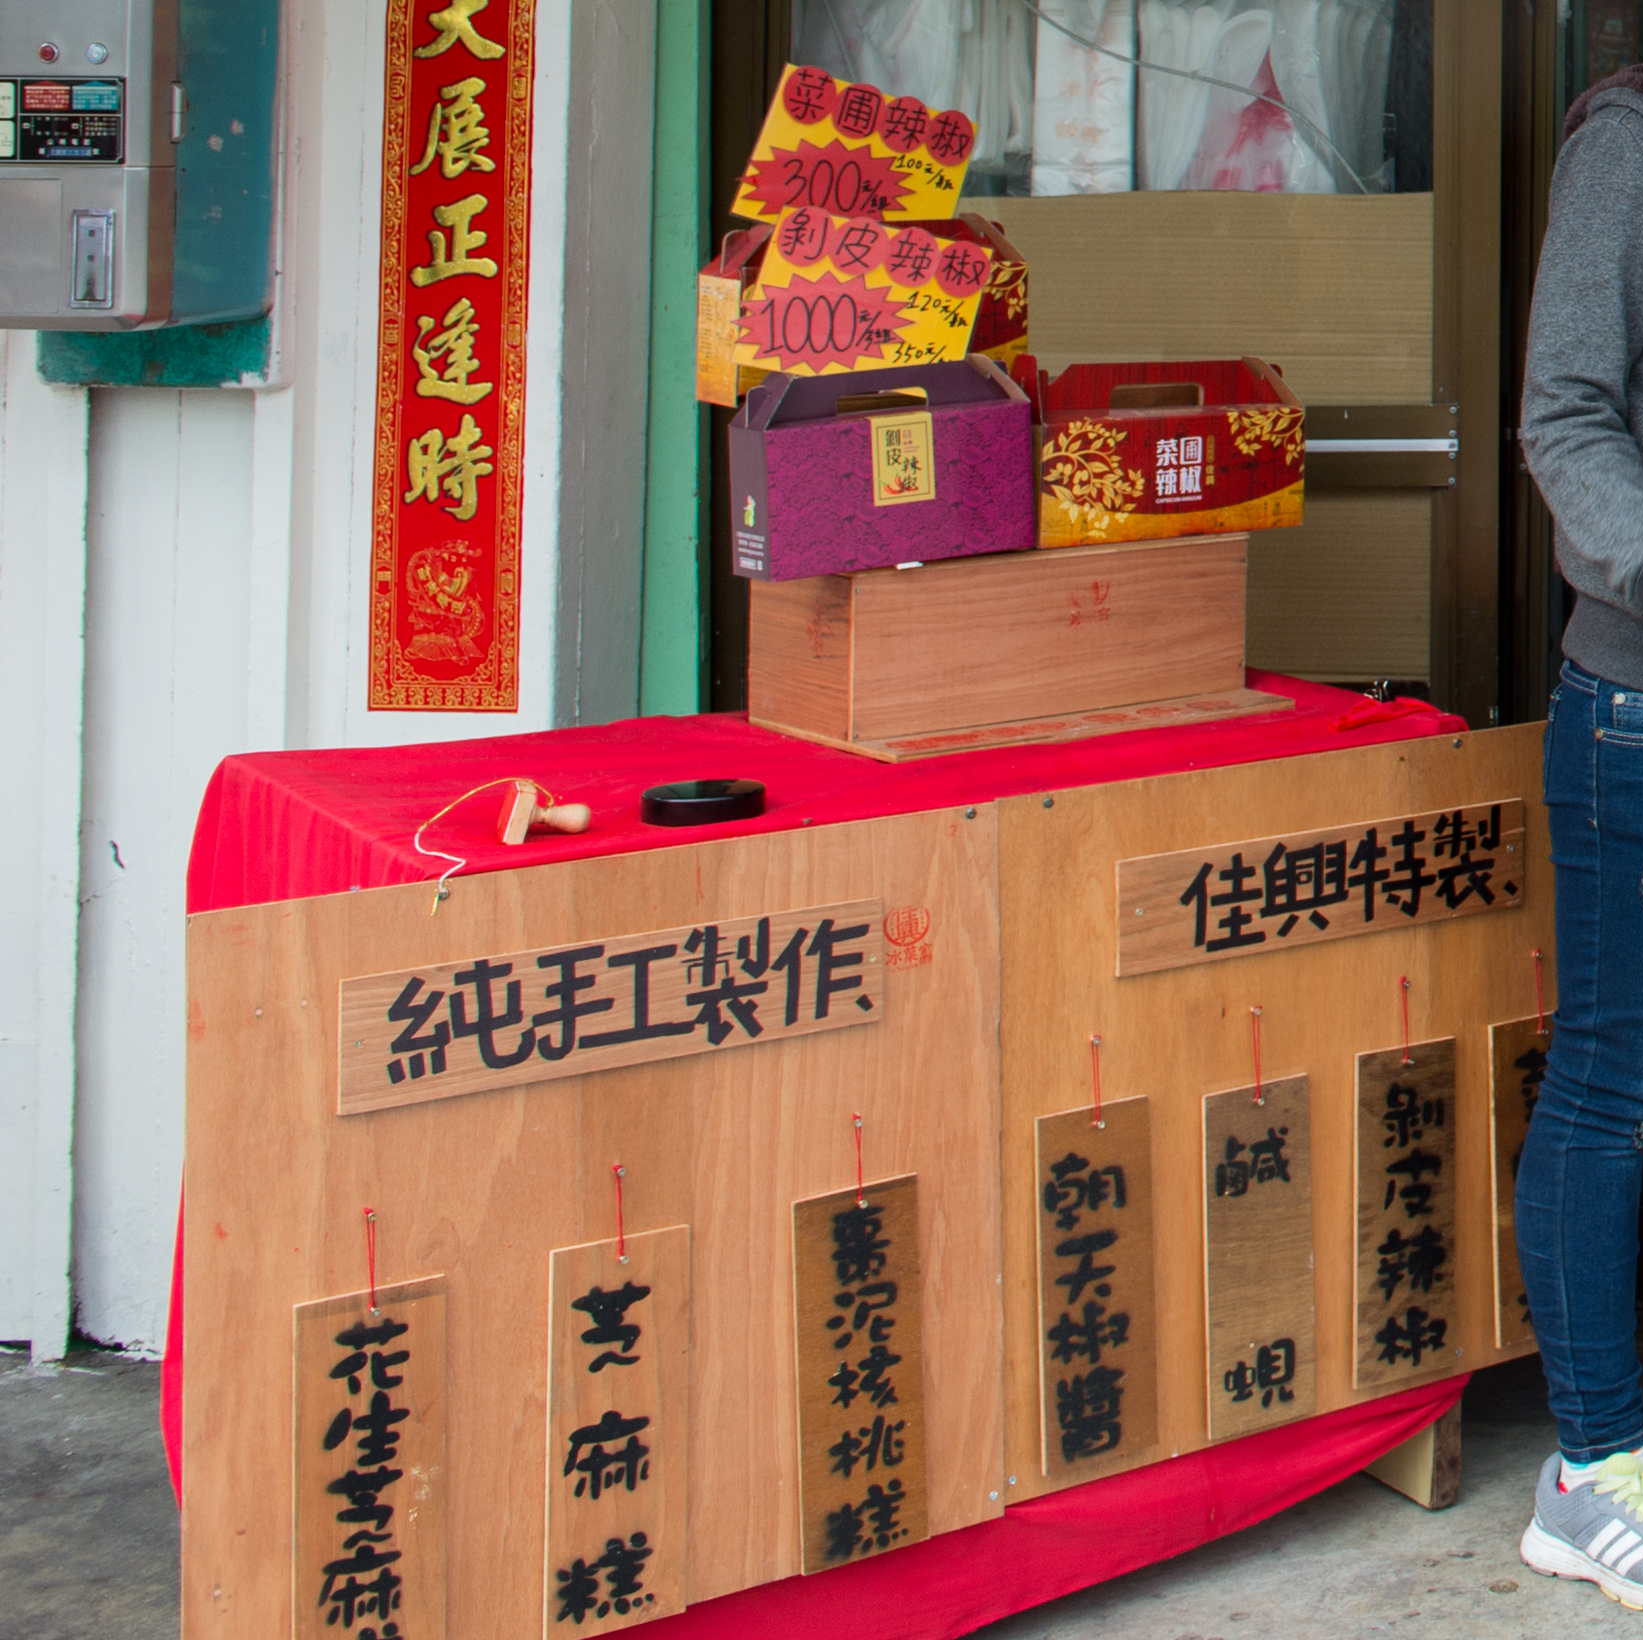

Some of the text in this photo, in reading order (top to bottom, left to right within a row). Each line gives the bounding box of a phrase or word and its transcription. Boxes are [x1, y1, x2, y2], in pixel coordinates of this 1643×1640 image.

[1156, 466, 1202, 496] 辣椒
[386, 916, 880, 1085] 純手工製作
[1179, 803, 1520, 954] 佳興特製
[1044, 1152, 1131, 1465] 朝天椒醬
[1214, 1126, 1296, 1410] 鹹蜆
[1375, 1082, 1449, 1368] 剝皮辣椒
[318, 1317, 412, 1640] 花生芝麻
[556, 1280, 656, 1624] 芝麻糕
[825, 1205, 909, 1563] 棗泥核桃糕
